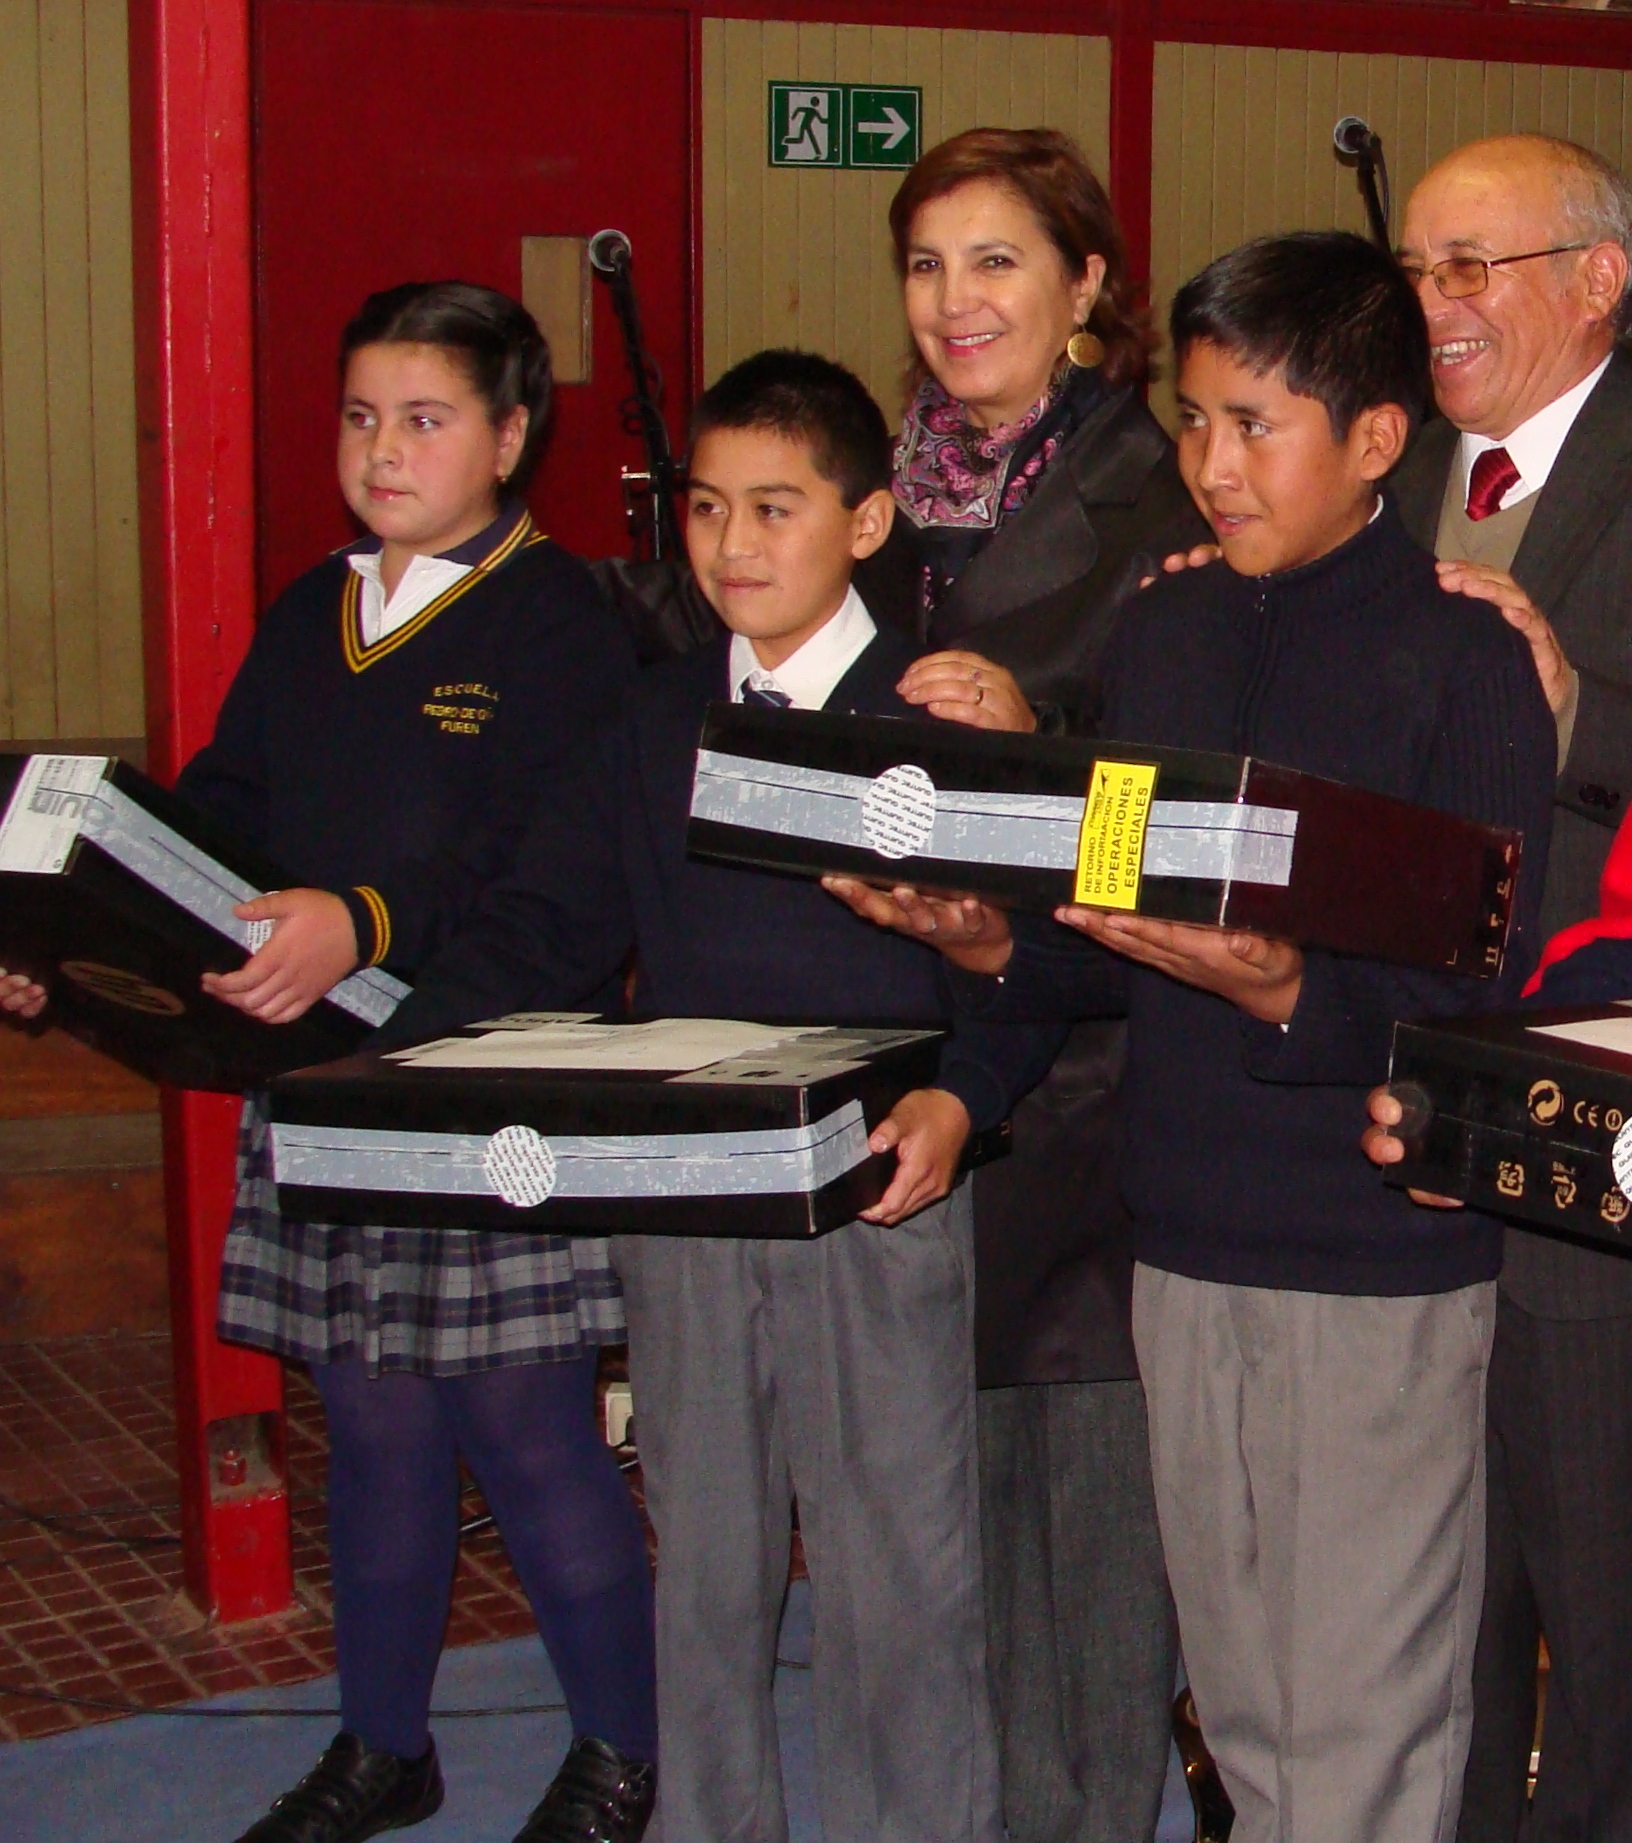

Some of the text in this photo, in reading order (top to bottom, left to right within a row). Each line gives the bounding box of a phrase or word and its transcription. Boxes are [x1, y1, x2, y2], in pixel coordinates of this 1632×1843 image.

[1084, 836, 1096, 893] RETORNO
[1107, 777, 1134, 895] OPERACIONES
[1124, 786, 1149, 888] ESPECIALES
[1094, 875, 1102, 894] DE
